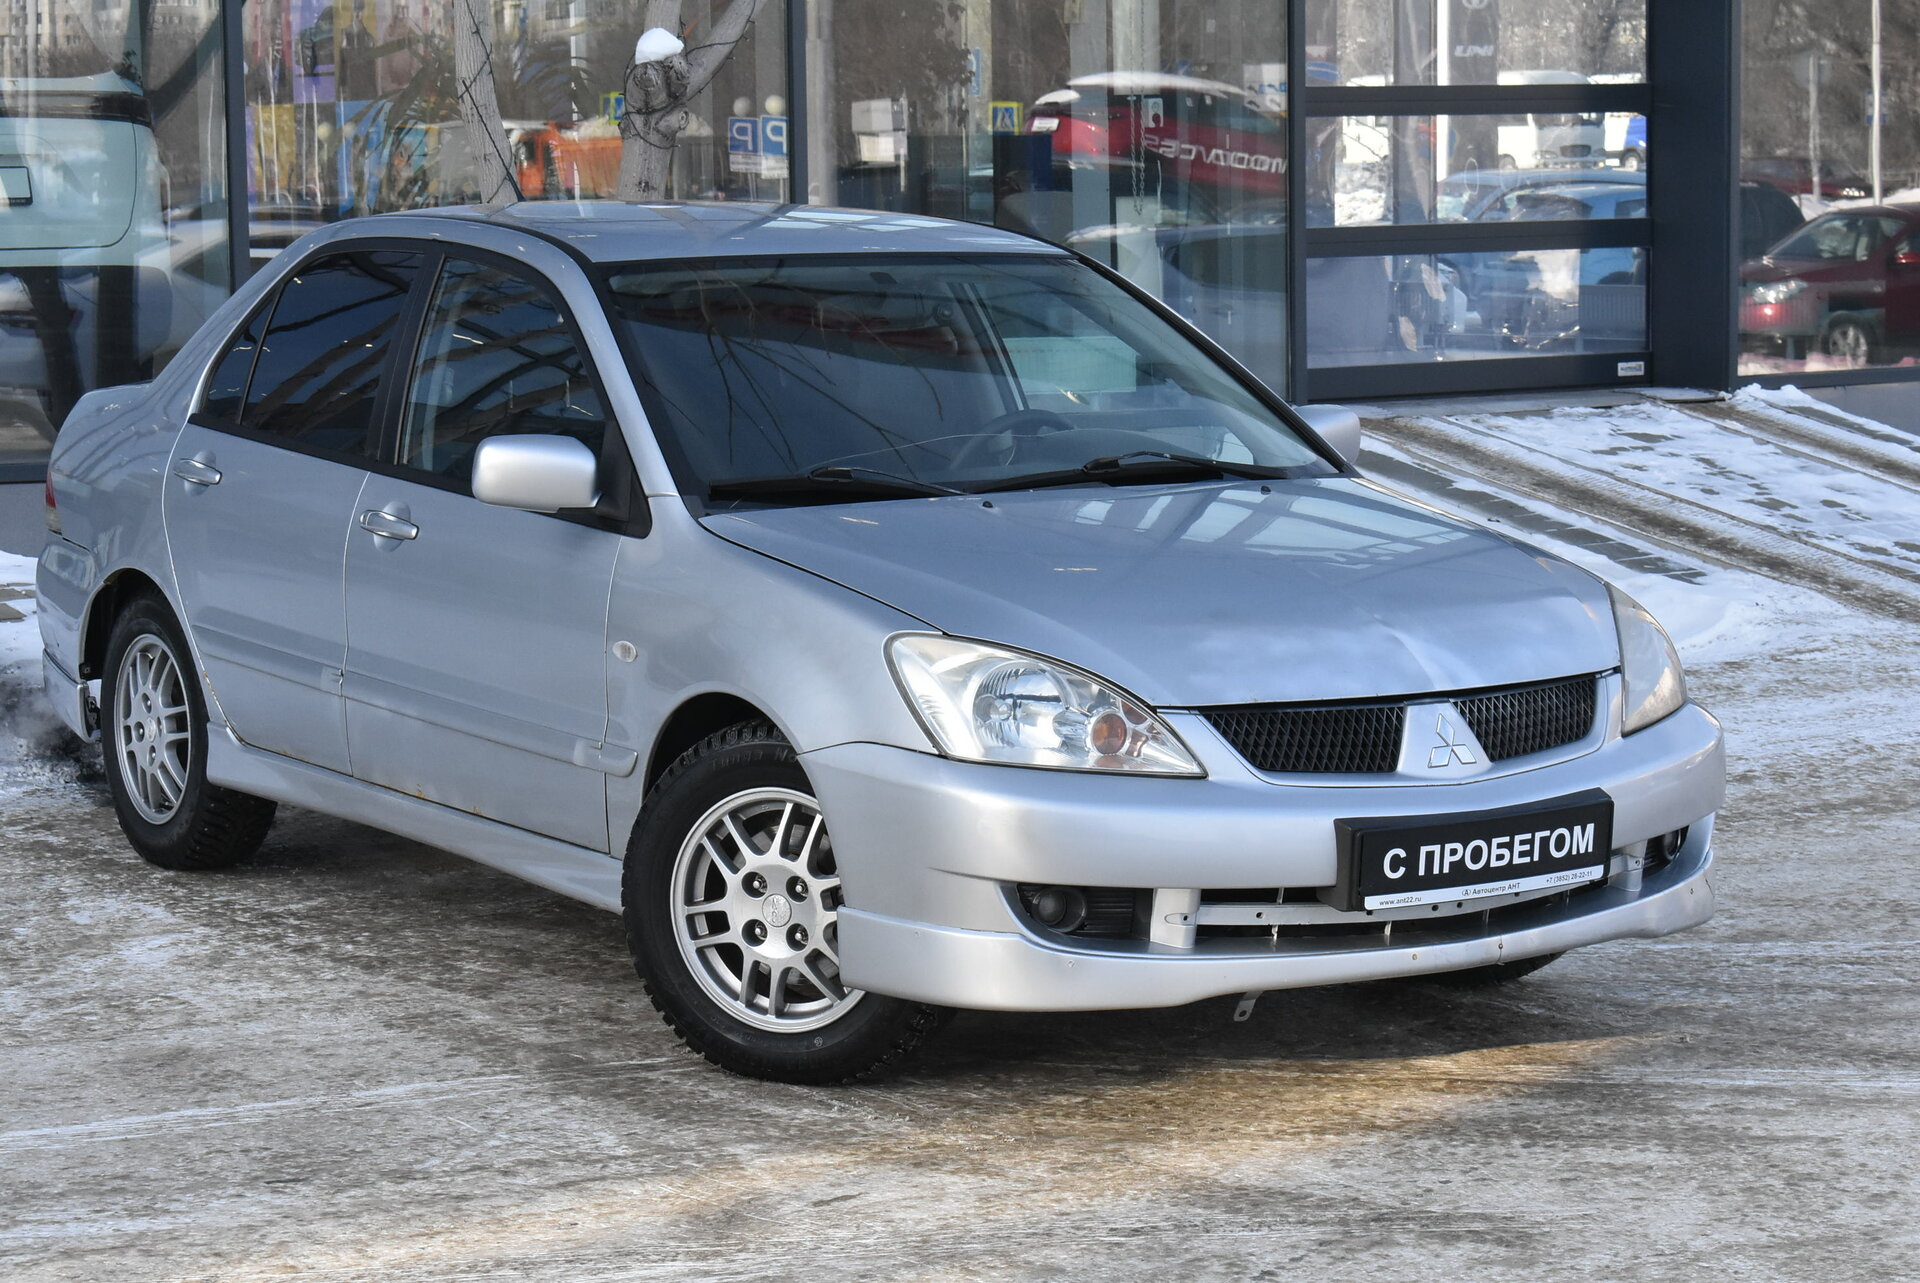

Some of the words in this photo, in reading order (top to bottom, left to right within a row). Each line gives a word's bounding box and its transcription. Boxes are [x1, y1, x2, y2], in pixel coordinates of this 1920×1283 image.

[1383, 847, 1407, 880] С
[1418, 822, 1595, 877] ПРОБЕГОМ
[1472, 884, 1507, 896] Автоцентр
[1507, 882, 1521, 890] АНТ
[1379, 896, 1422, 906] www.ant22.ru
